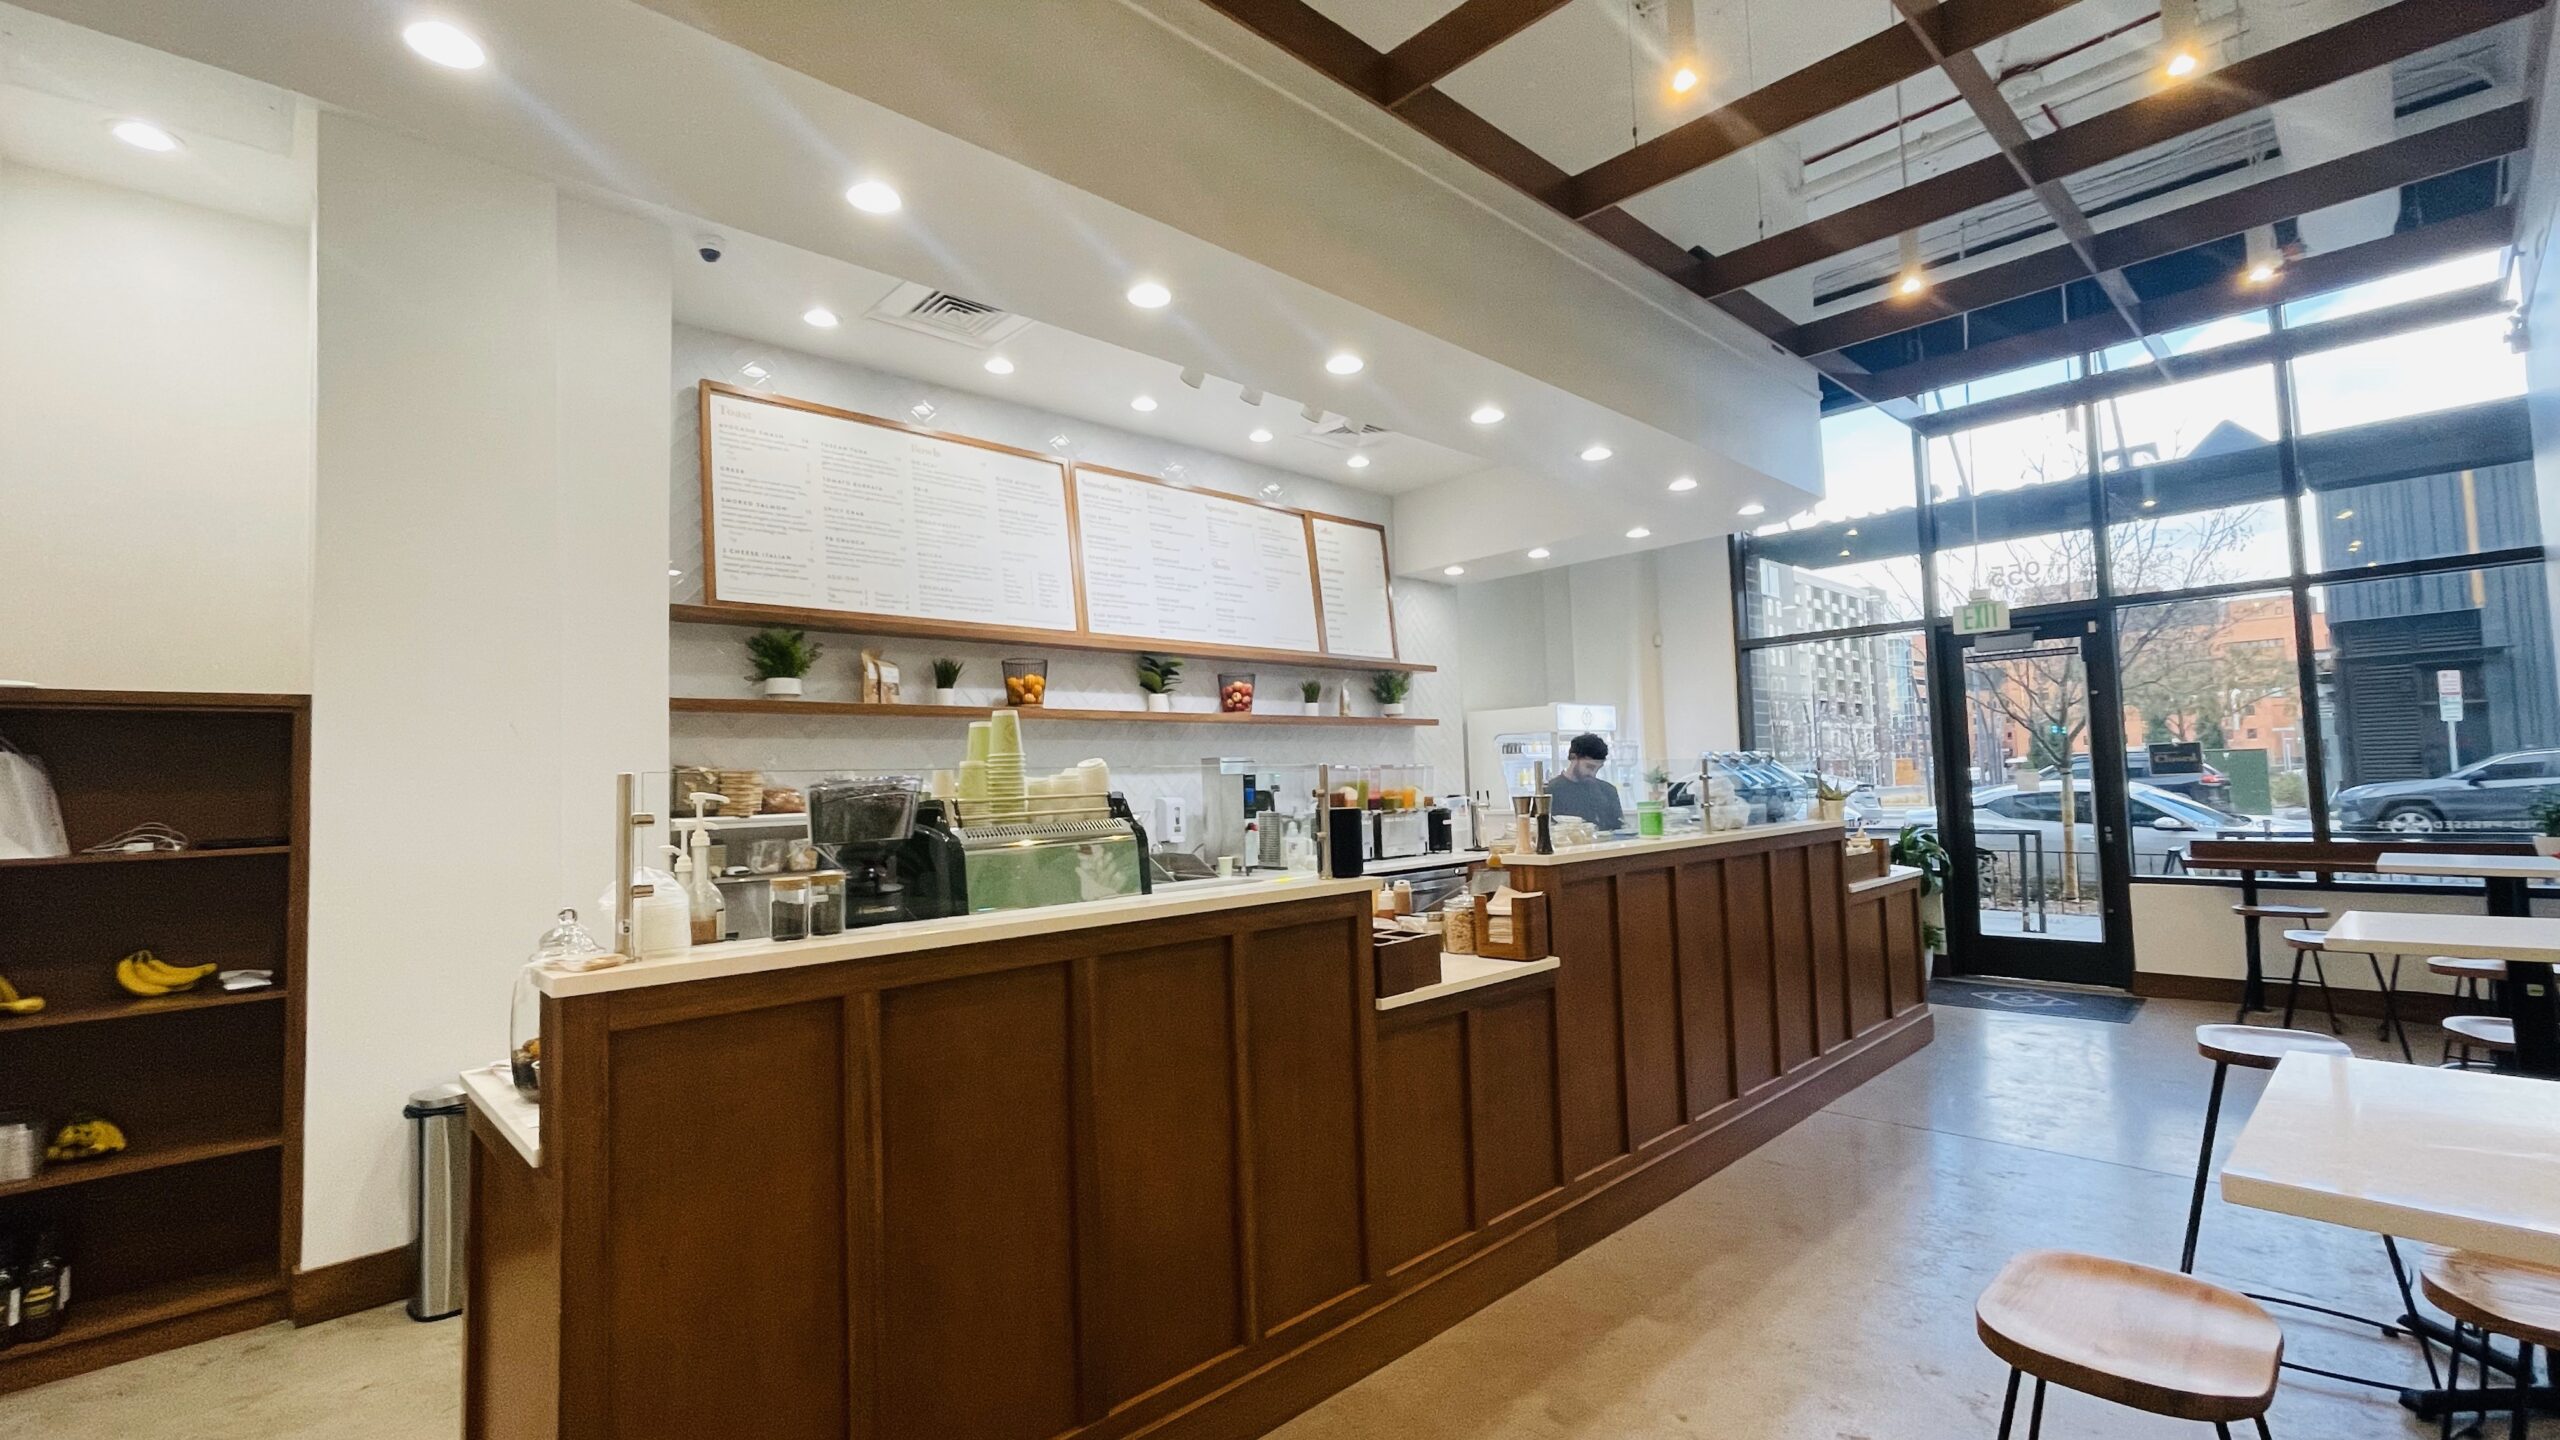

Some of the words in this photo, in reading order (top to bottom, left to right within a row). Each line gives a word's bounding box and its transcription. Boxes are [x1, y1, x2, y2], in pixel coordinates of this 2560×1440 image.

[719, 404, 752, 419] Toast
[729, 548, 759, 557] CHEESE
[761, 552, 792, 560] ITALIAN
[1963, 603, 1999, 630] EXIT
